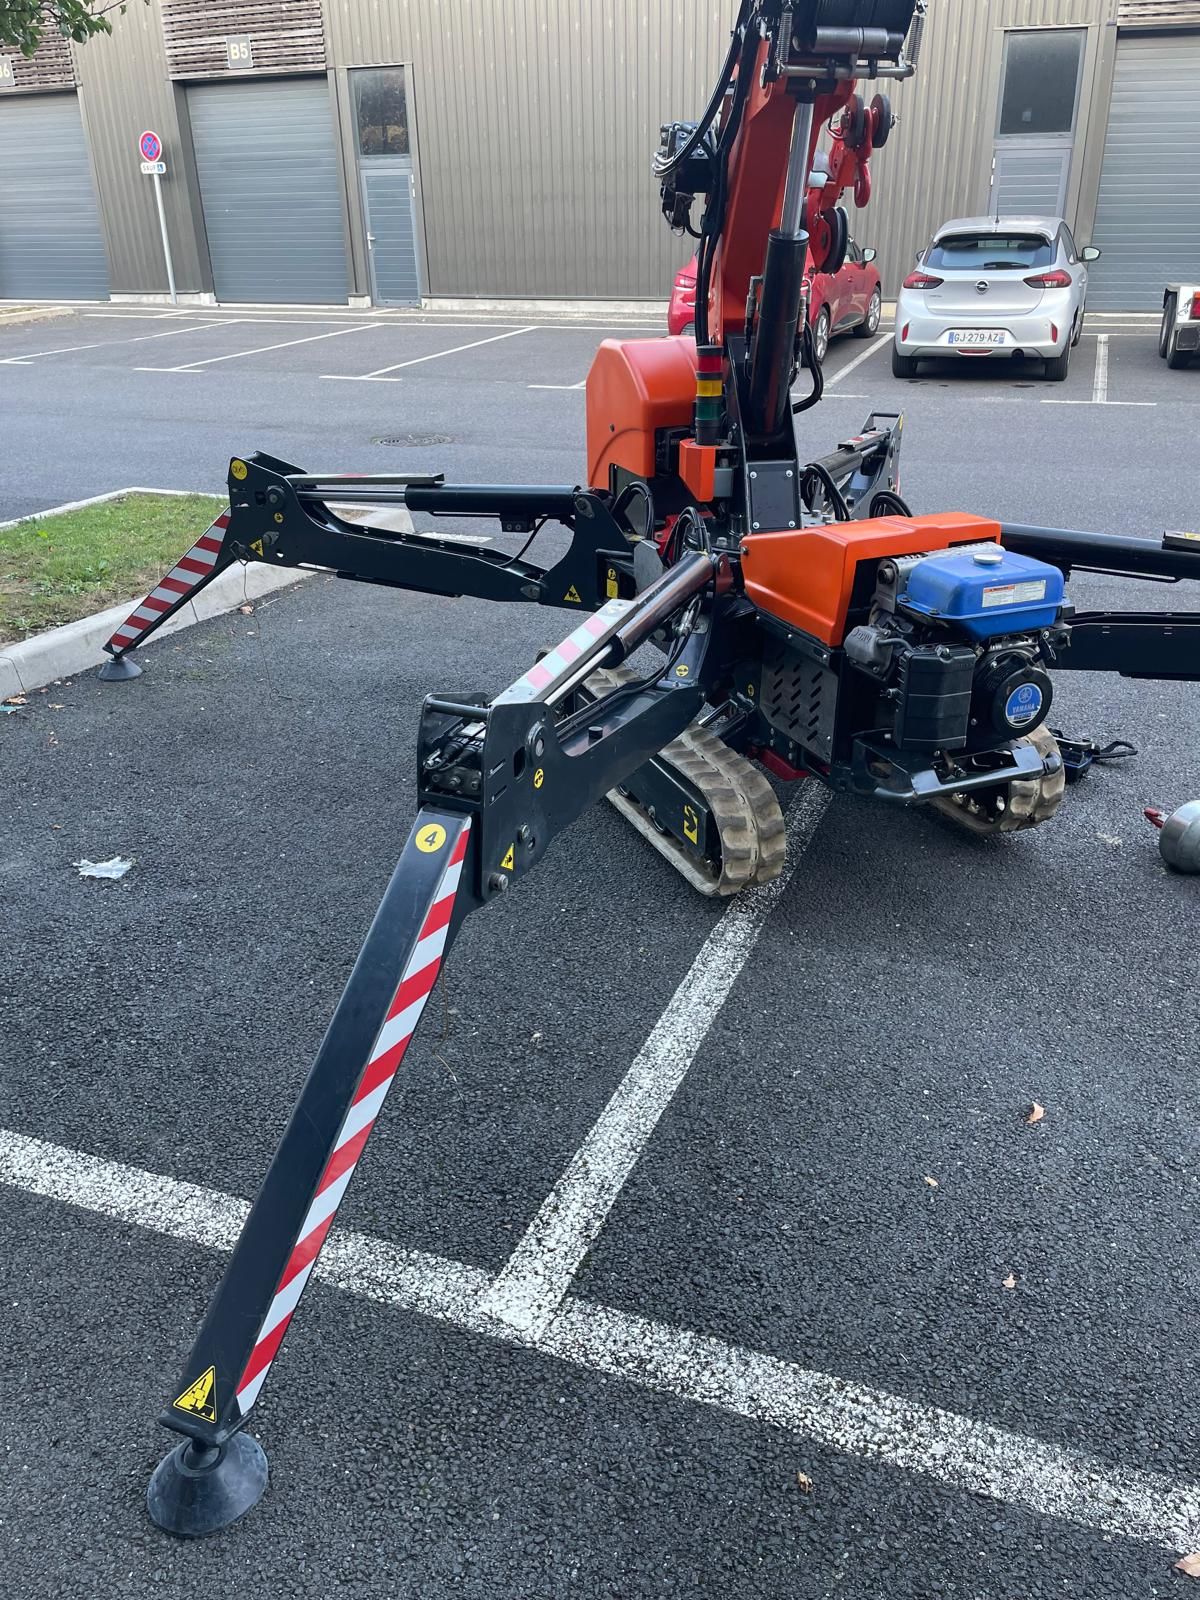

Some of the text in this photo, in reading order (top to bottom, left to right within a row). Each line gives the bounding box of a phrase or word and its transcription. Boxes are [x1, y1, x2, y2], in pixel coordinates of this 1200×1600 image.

[230, 42, 249, 60] B5
[0, 62, 11, 78] 6
[954, 333, 999, 343] GJ-279-AZ
[1012, 703, 1036, 714] YAMAHA
[424, 831, 437, 847] 4
